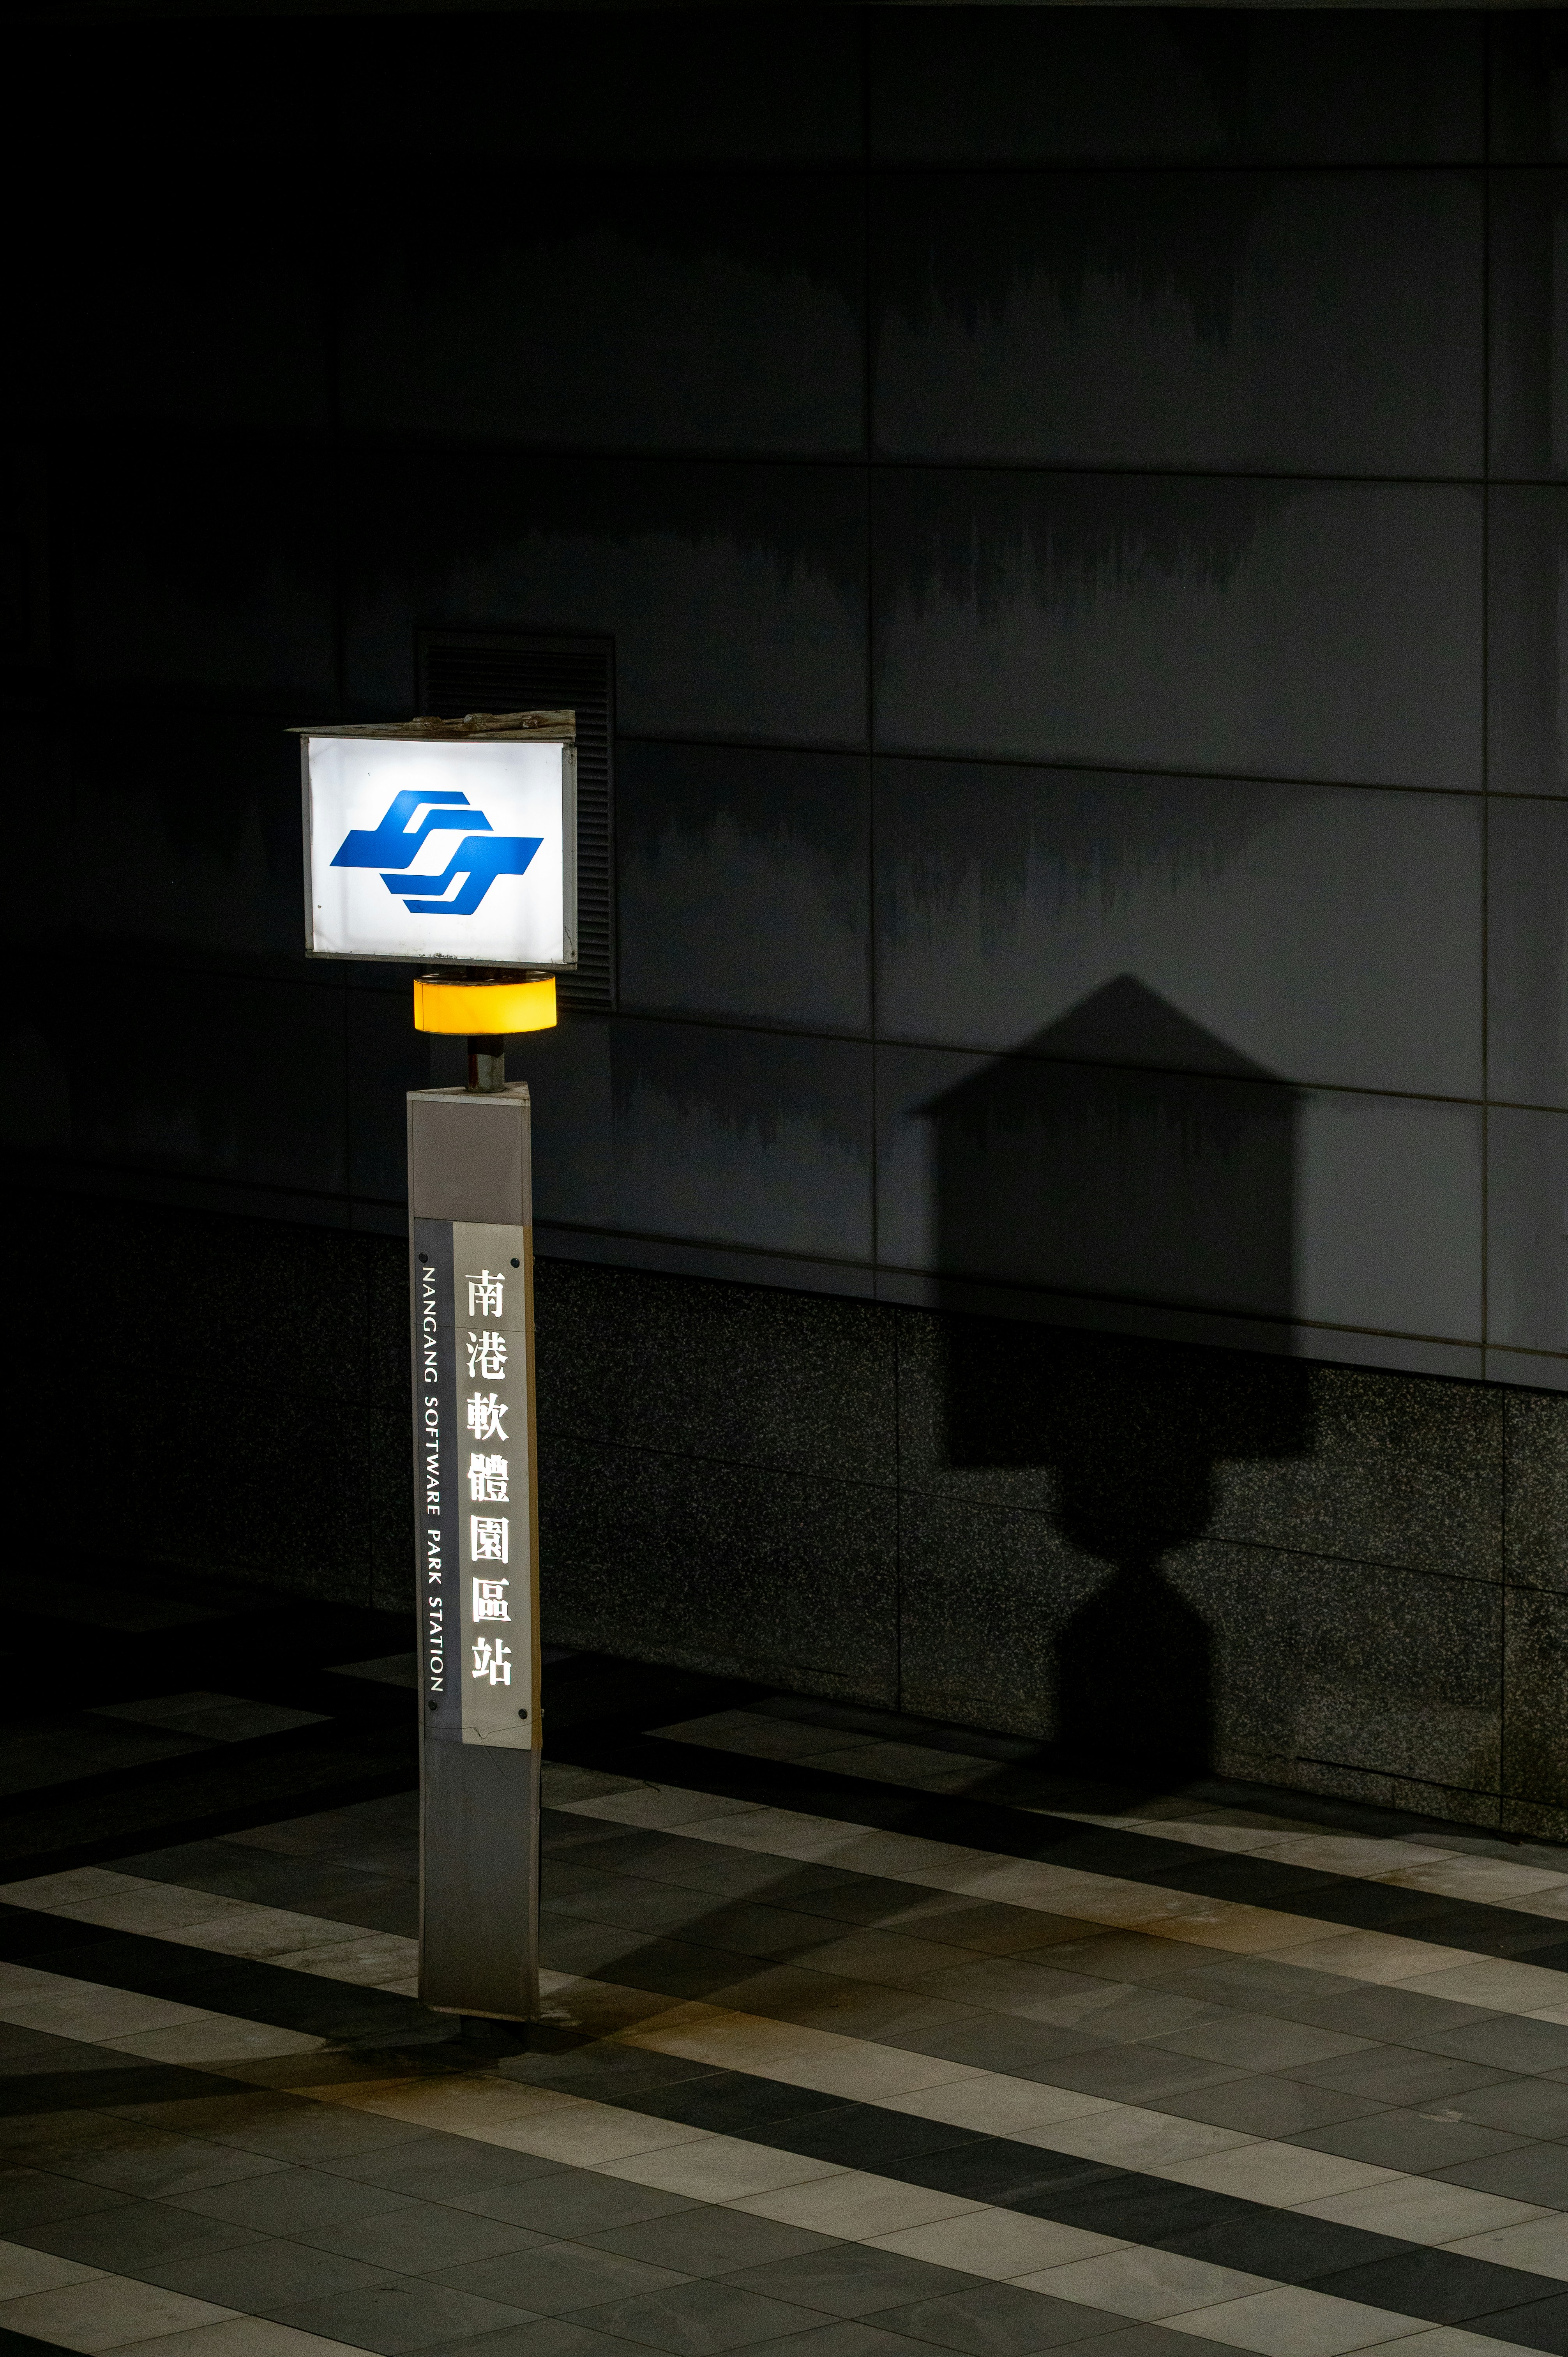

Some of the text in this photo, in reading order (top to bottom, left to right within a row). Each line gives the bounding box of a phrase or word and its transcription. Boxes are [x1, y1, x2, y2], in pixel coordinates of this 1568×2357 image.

[422, 1267, 443, 1692] NANGANG SOFTWARE PARK STATION
[465, 1269, 512, 1686] 南港軟體園區站
